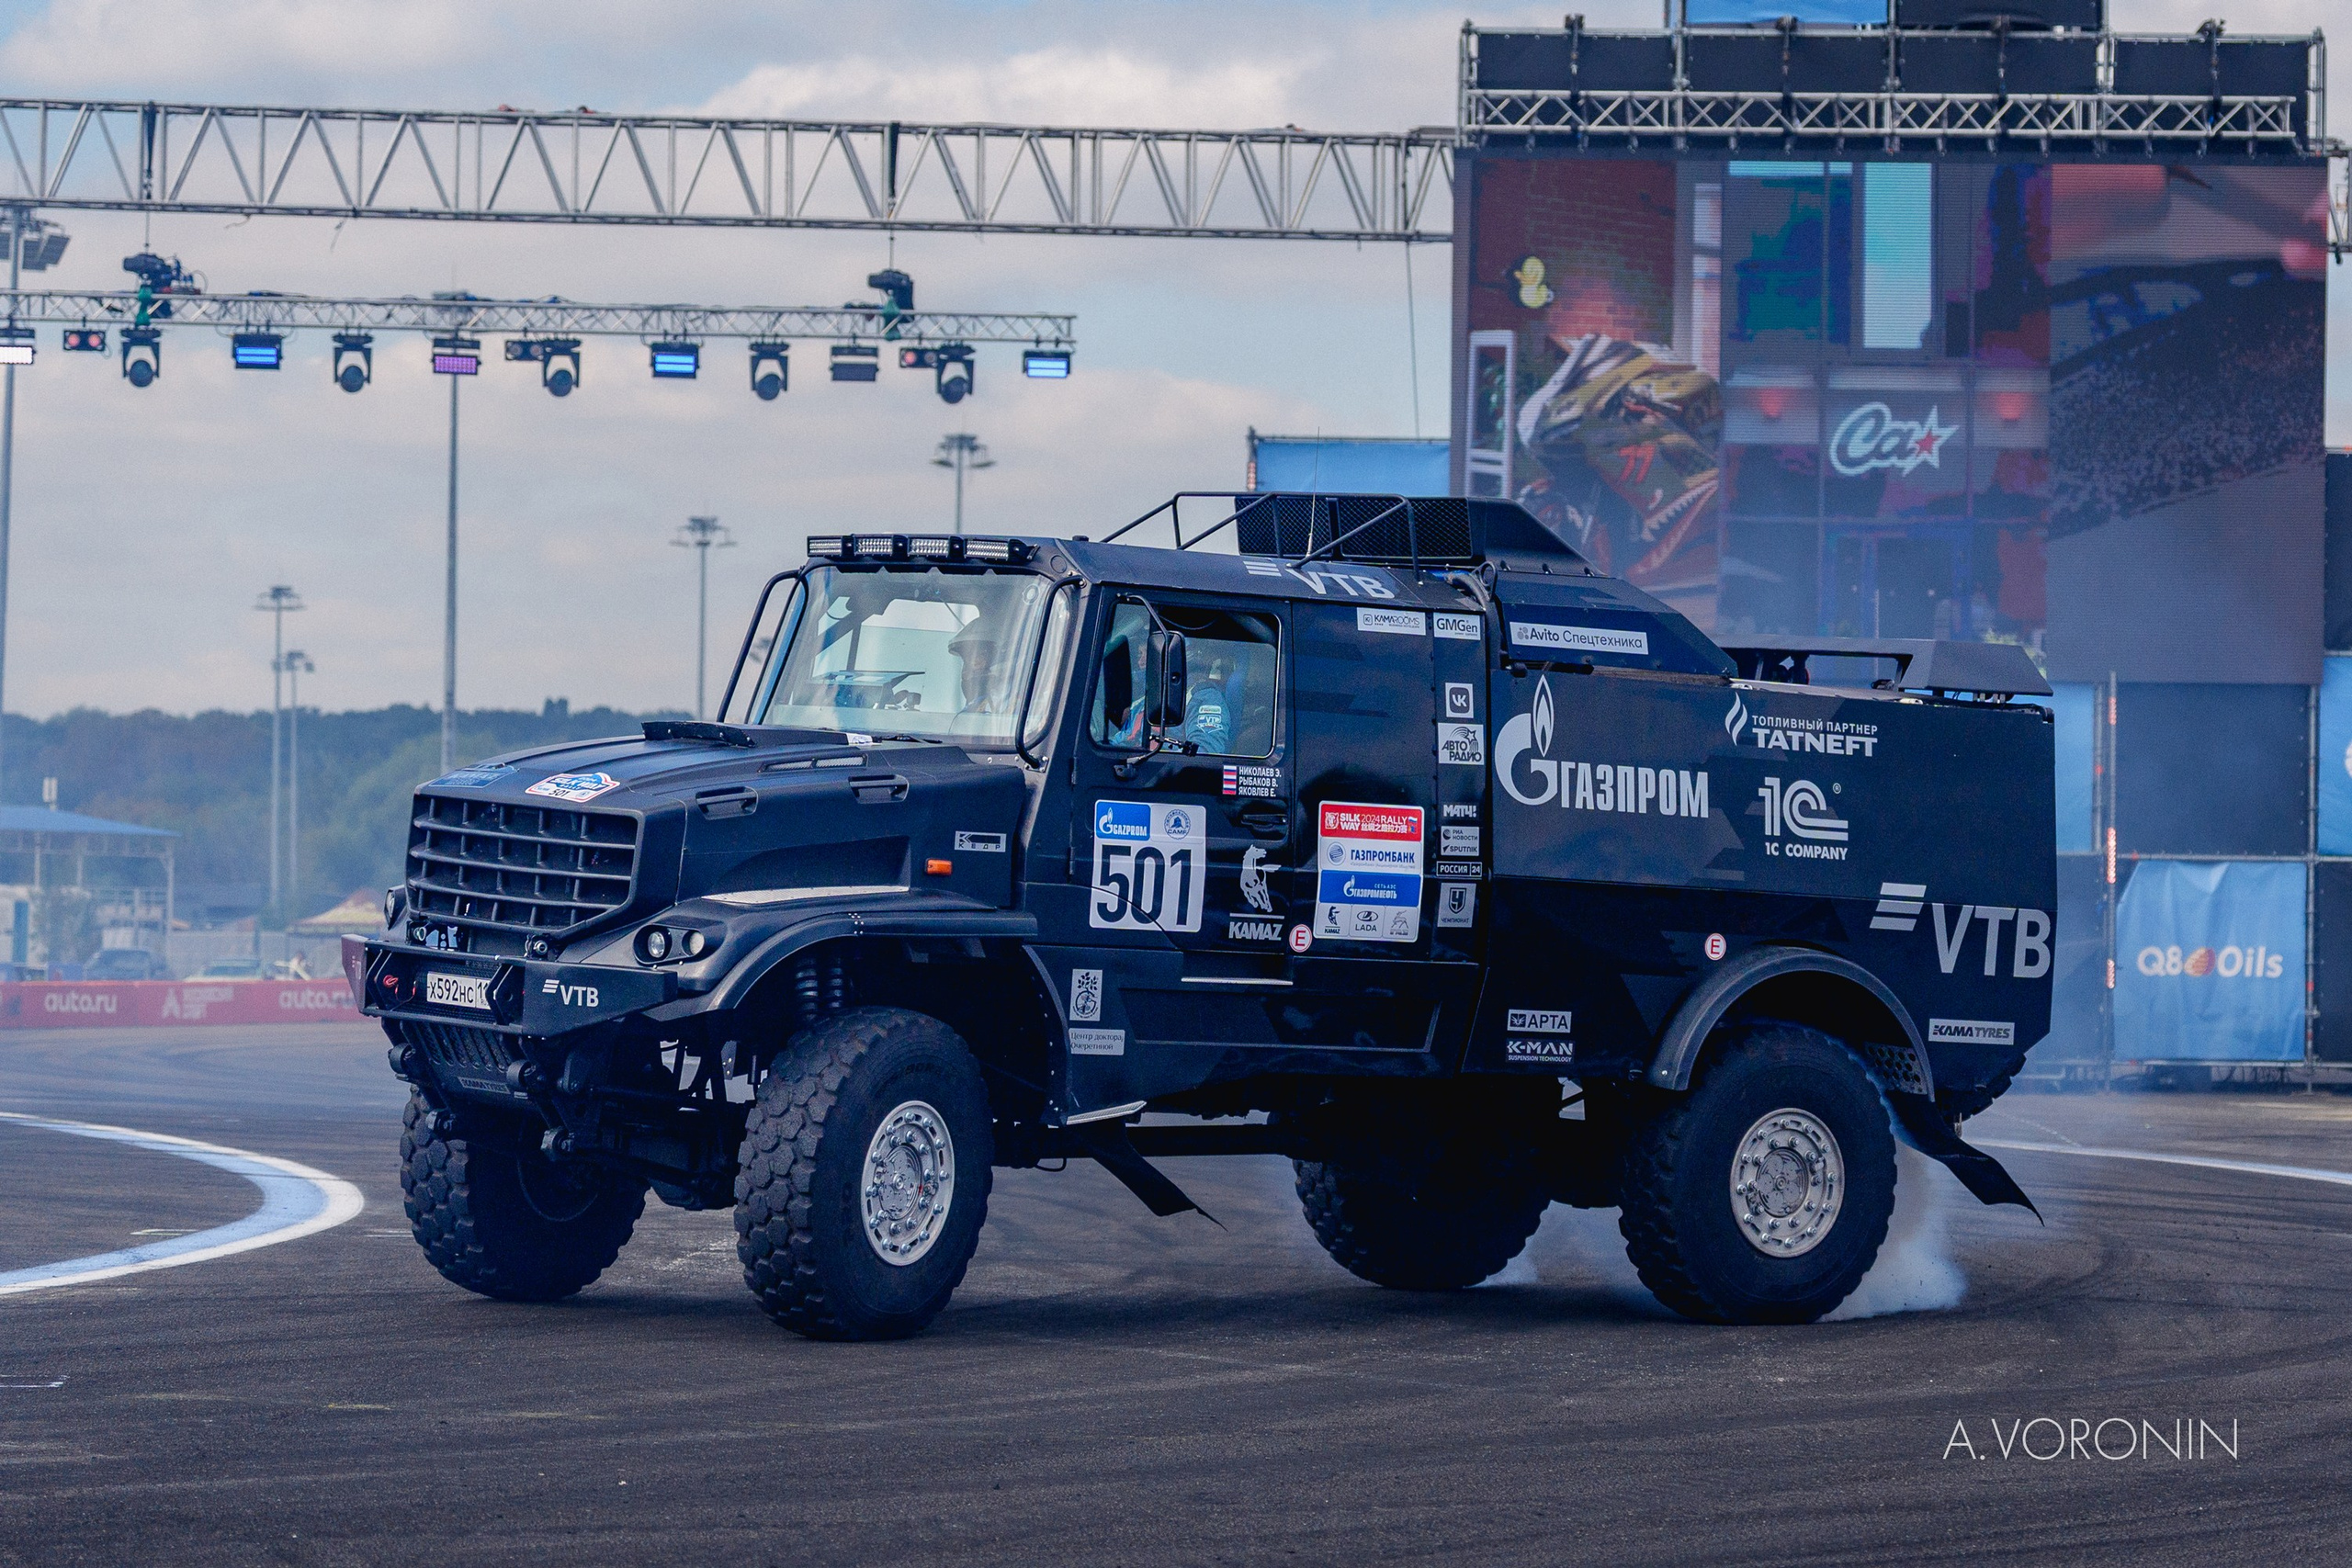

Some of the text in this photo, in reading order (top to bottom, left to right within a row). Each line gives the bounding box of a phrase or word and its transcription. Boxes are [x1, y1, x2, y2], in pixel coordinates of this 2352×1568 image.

[1285, 568, 1395, 598] VTB
[1530, 627, 1643, 649] Avito Спецтехника
[1452, 694, 1467, 707] VK
[1752, 715, 1878, 735] ТОПЛИВНЫЙ ПАРТНЕР
[1442, 740, 1468, 750] АВТО
[1752, 728, 1878, 757] TATNEFT
[1449, 750, 1482, 762] РАДИО
[1238, 766, 1282, 777] НИКОЛАЕВ Э.
[1238, 776, 1271, 786] РЫБАКОВ
[548, 789, 571, 797] 501
[1238, 787, 1269, 796] ЯКОВЛЕВ
[1561, 761, 1709, 818] ГАЗПРОМ
[1443, 805, 1477, 818] МАТЧ!
[1340, 813, 1408, 825] SILK 2024 RALLY
[1113, 824, 1148, 837] GAZPROM
[1340, 822, 1360, 830] WAY
[1351, 850, 1415, 863] ГАЗПРОМБАНК
[1765, 842, 1849, 860] 1C COMPANY
[1440, 864, 1480, 874] РОССИЯ 24
[1097, 844, 1192, 926] 501
[1228, 921, 1283, 942] KAMAZ
[1295, 930, 1306, 947] E
[1932, 903, 2051, 978] VTB
[1711, 939, 1721, 954] E
[2137, 945, 2283, 978] Q8 Oils
[45, 991, 118, 1013] auto.ru
[560, 985, 599, 1008] VTB
[1070, 1032, 1093, 1041] Центр
[1932, 1025, 2011, 1038] KAMA TYRES
[1507, 1041, 1574, 1055] K-MAN
